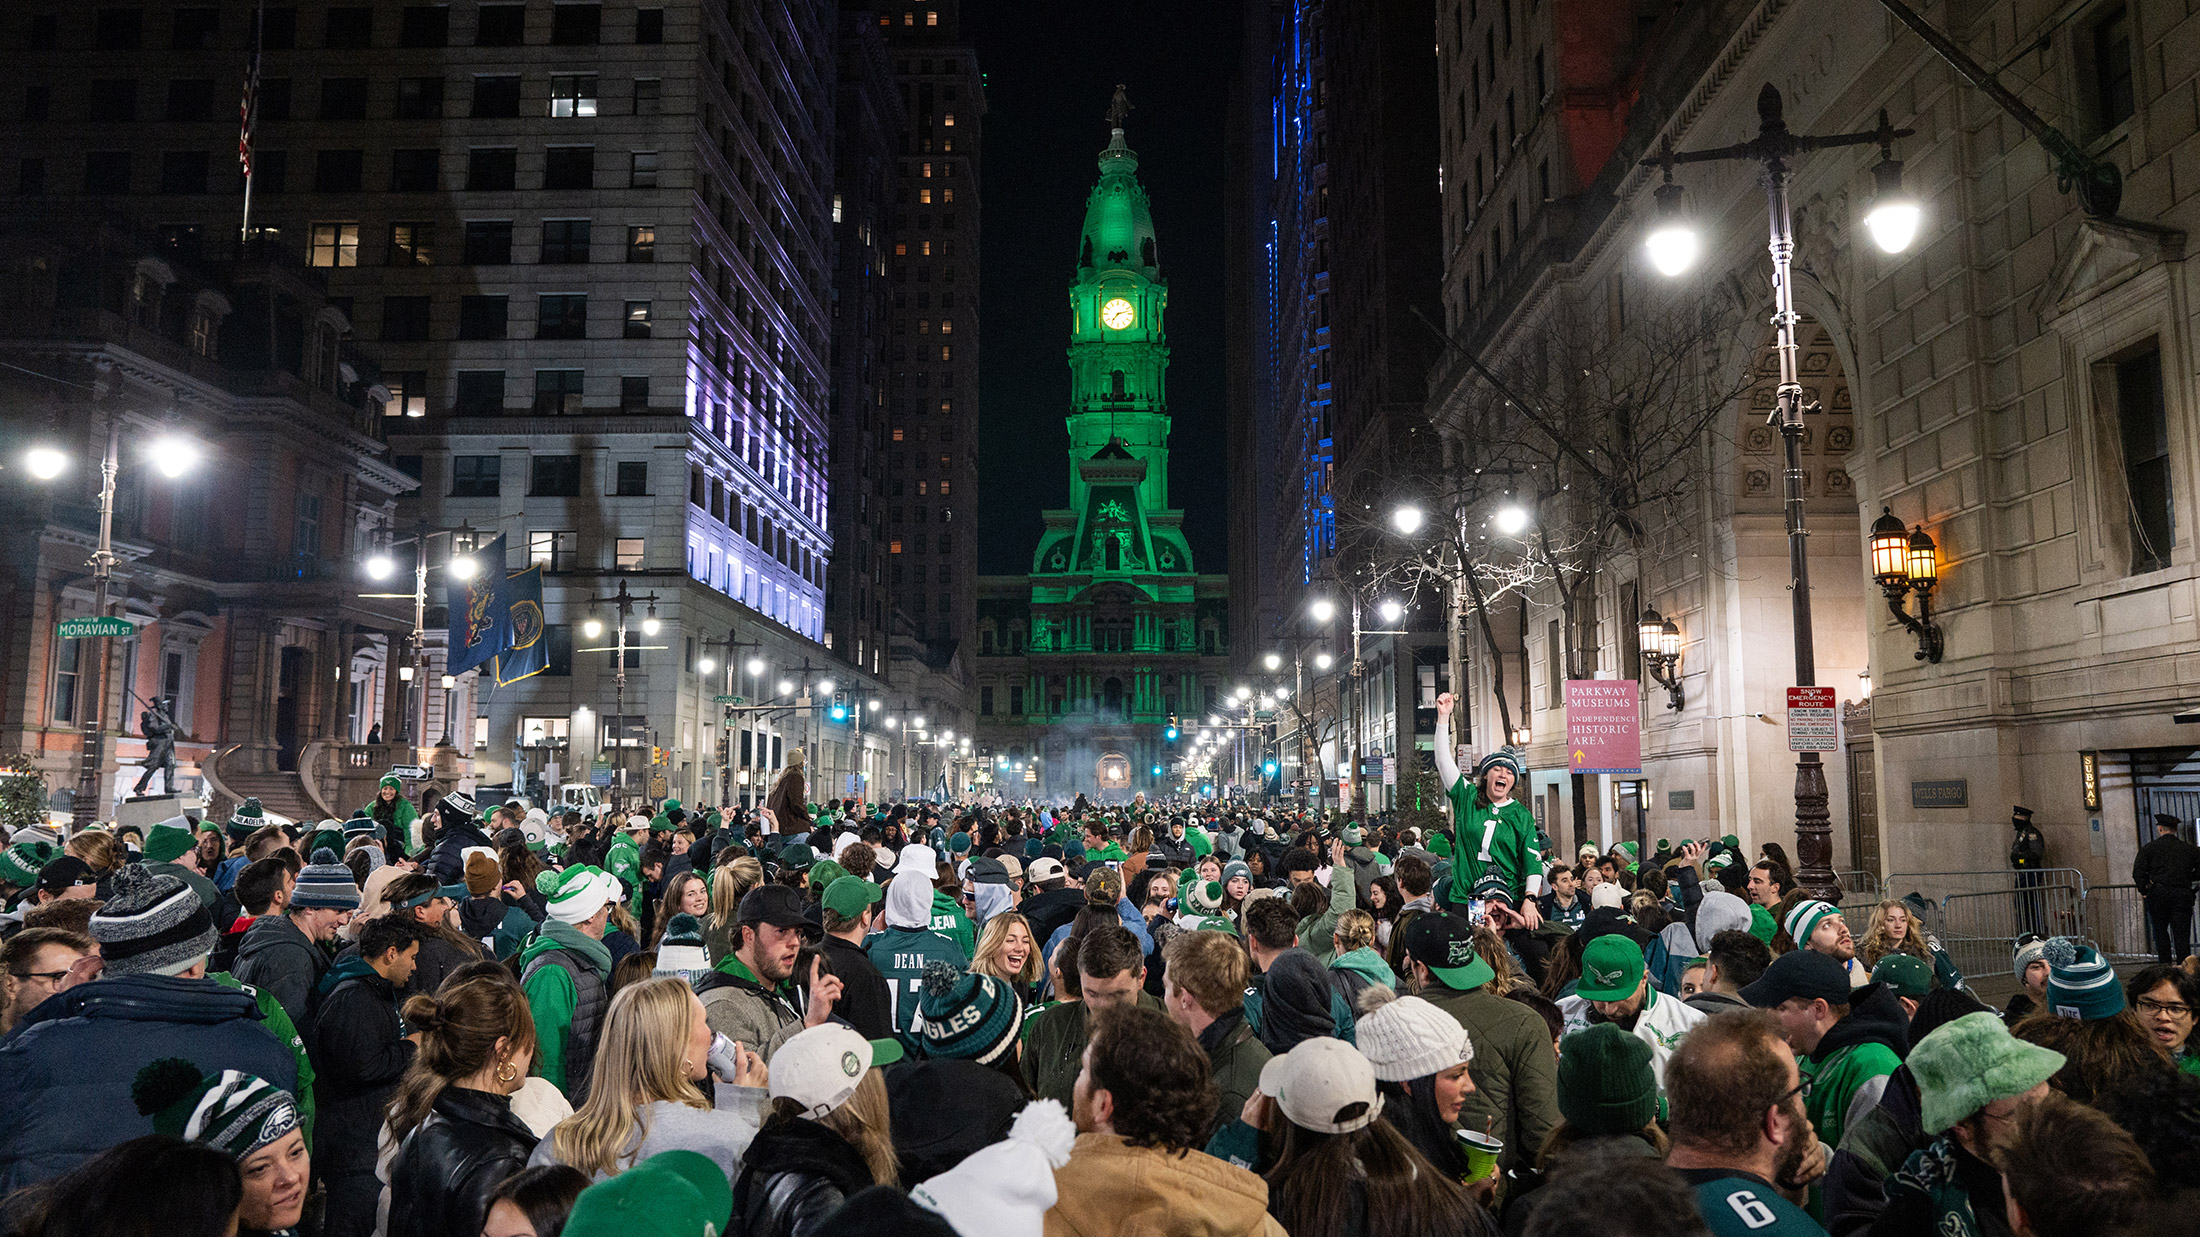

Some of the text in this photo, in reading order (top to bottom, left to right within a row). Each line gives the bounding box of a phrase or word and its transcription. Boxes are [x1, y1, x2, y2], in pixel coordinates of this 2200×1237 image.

[60, 624, 131, 635] MORAVIAN ST
[1571, 687, 1627, 696] PARKWAY
[1571, 698, 1631, 708] MUSEUMS
[1572, 715, 1637, 723] INDEPENDENCE
[1572, 724, 1629, 734] HISTORIC
[1573, 736, 1605, 745] AREA
[2084, 756, 2095, 807] SUBWAY
[1914, 786, 1963, 799] WELLS FARGO
[1477, 819, 1498, 862] 1
[894, 953, 924, 969] DEAN
[924, 1004, 982, 1040] GLES
[1726, 1190, 1777, 1229] 6
